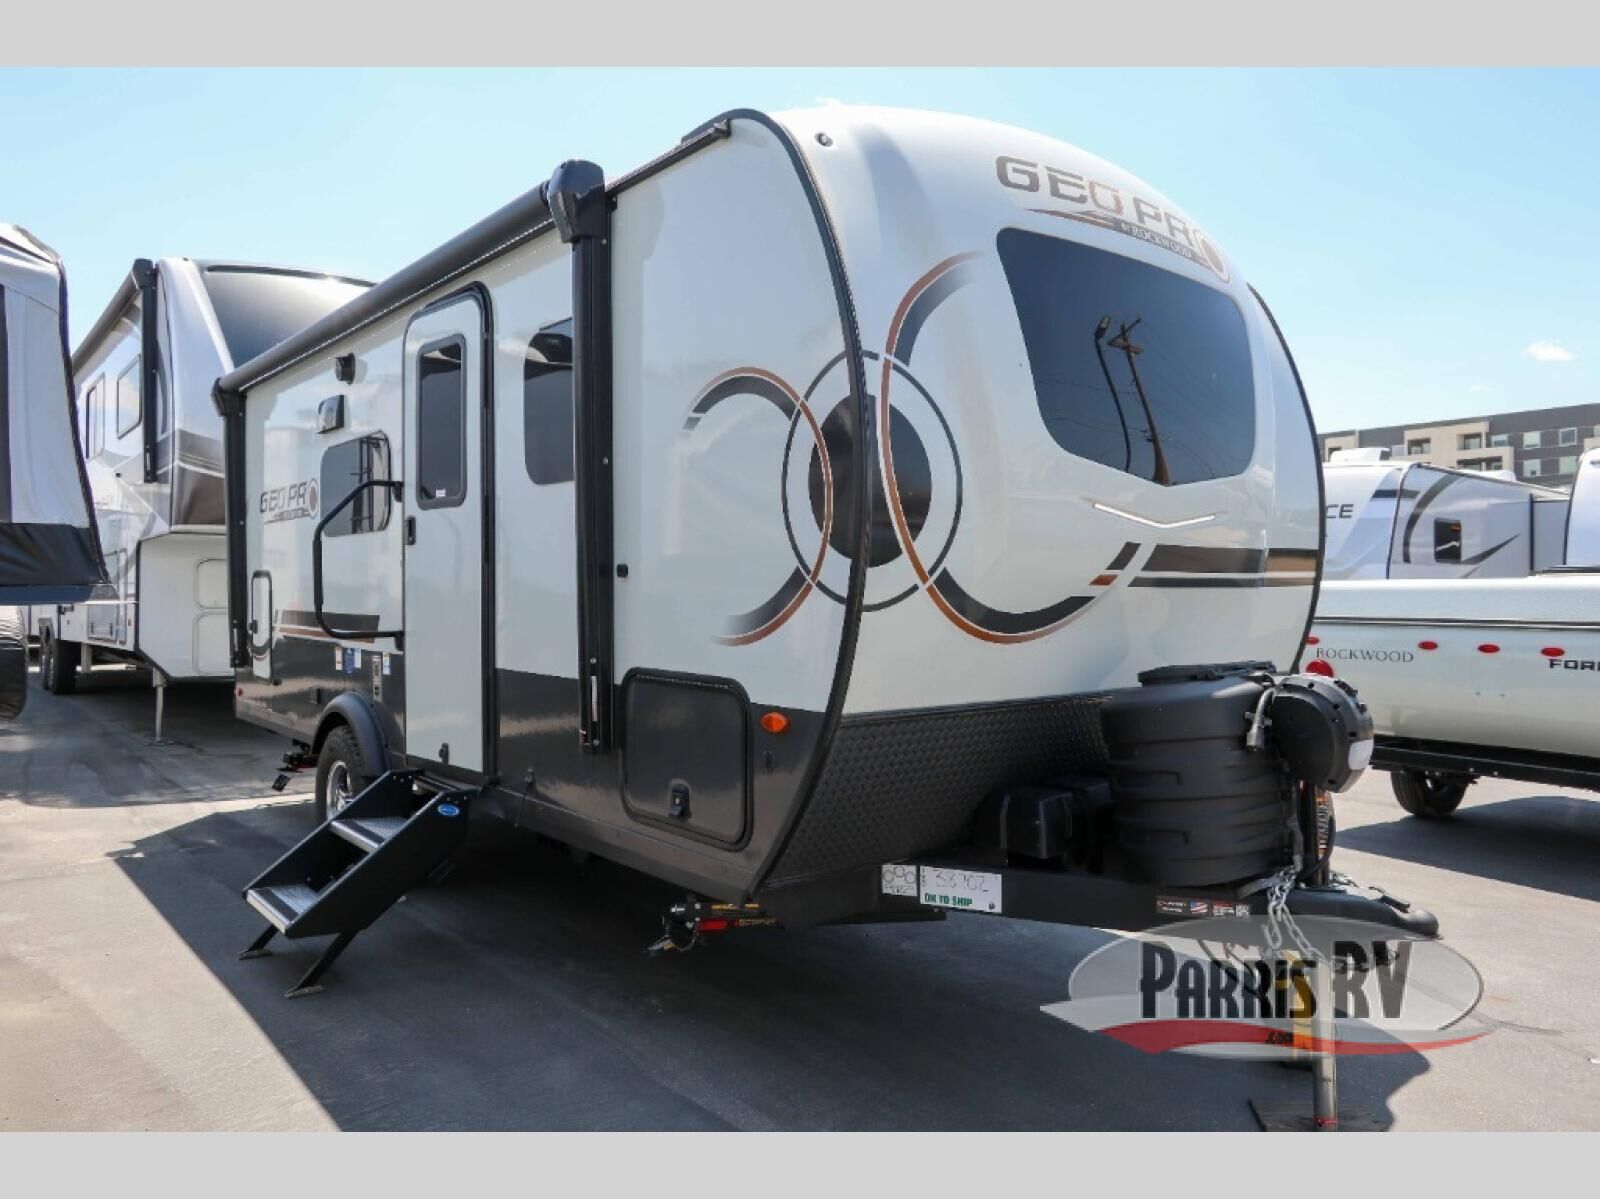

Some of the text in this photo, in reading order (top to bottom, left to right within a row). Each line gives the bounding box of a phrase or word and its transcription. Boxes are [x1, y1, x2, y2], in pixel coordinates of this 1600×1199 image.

[995, 155, 1232, 283] GEO PRO
[1316, 647, 1414, 663] ROCKWOOD
[1548, 658, 1600, 672] FOR
[924, 892, 973, 907] OK TO SHIP
